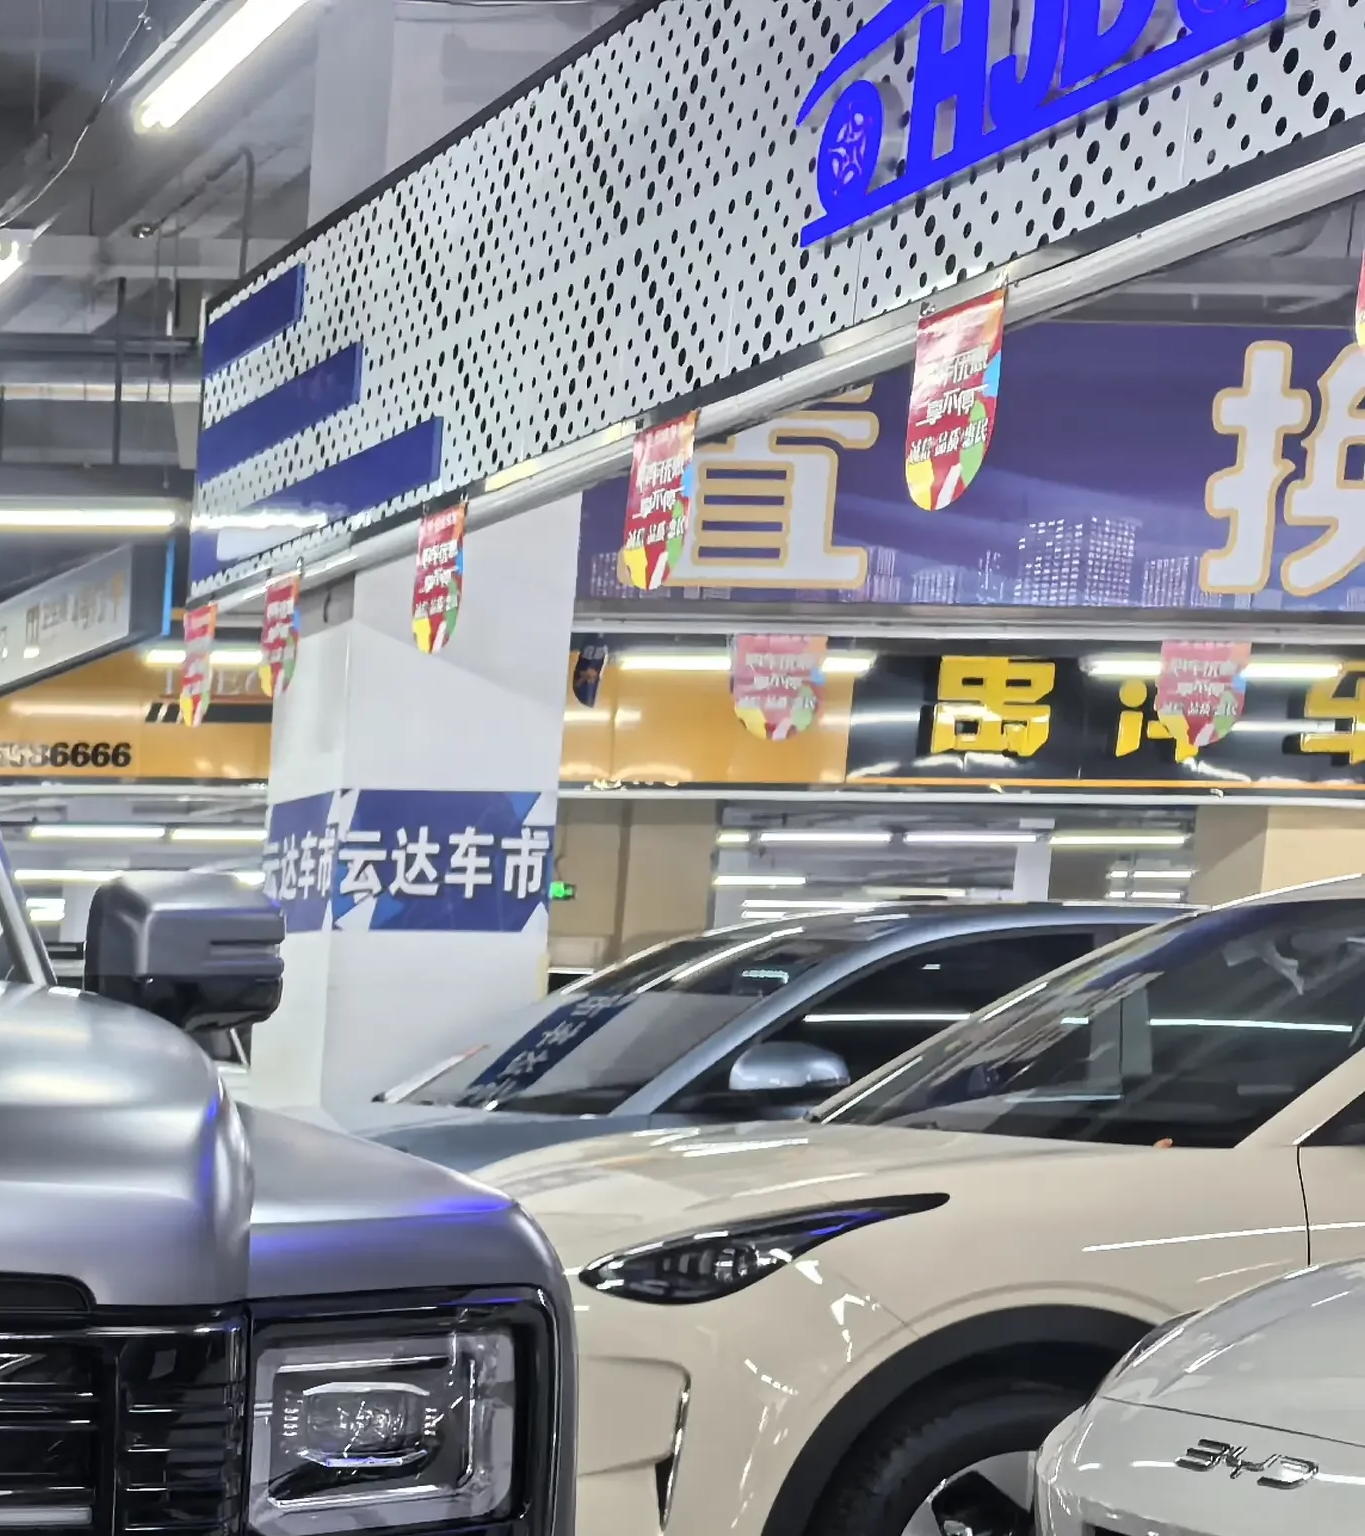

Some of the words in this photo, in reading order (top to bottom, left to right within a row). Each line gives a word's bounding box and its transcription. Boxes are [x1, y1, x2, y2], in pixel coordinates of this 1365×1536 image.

[338, 825, 550, 901] 云达车市
[1174, 1438, 1320, 1490] BYD
